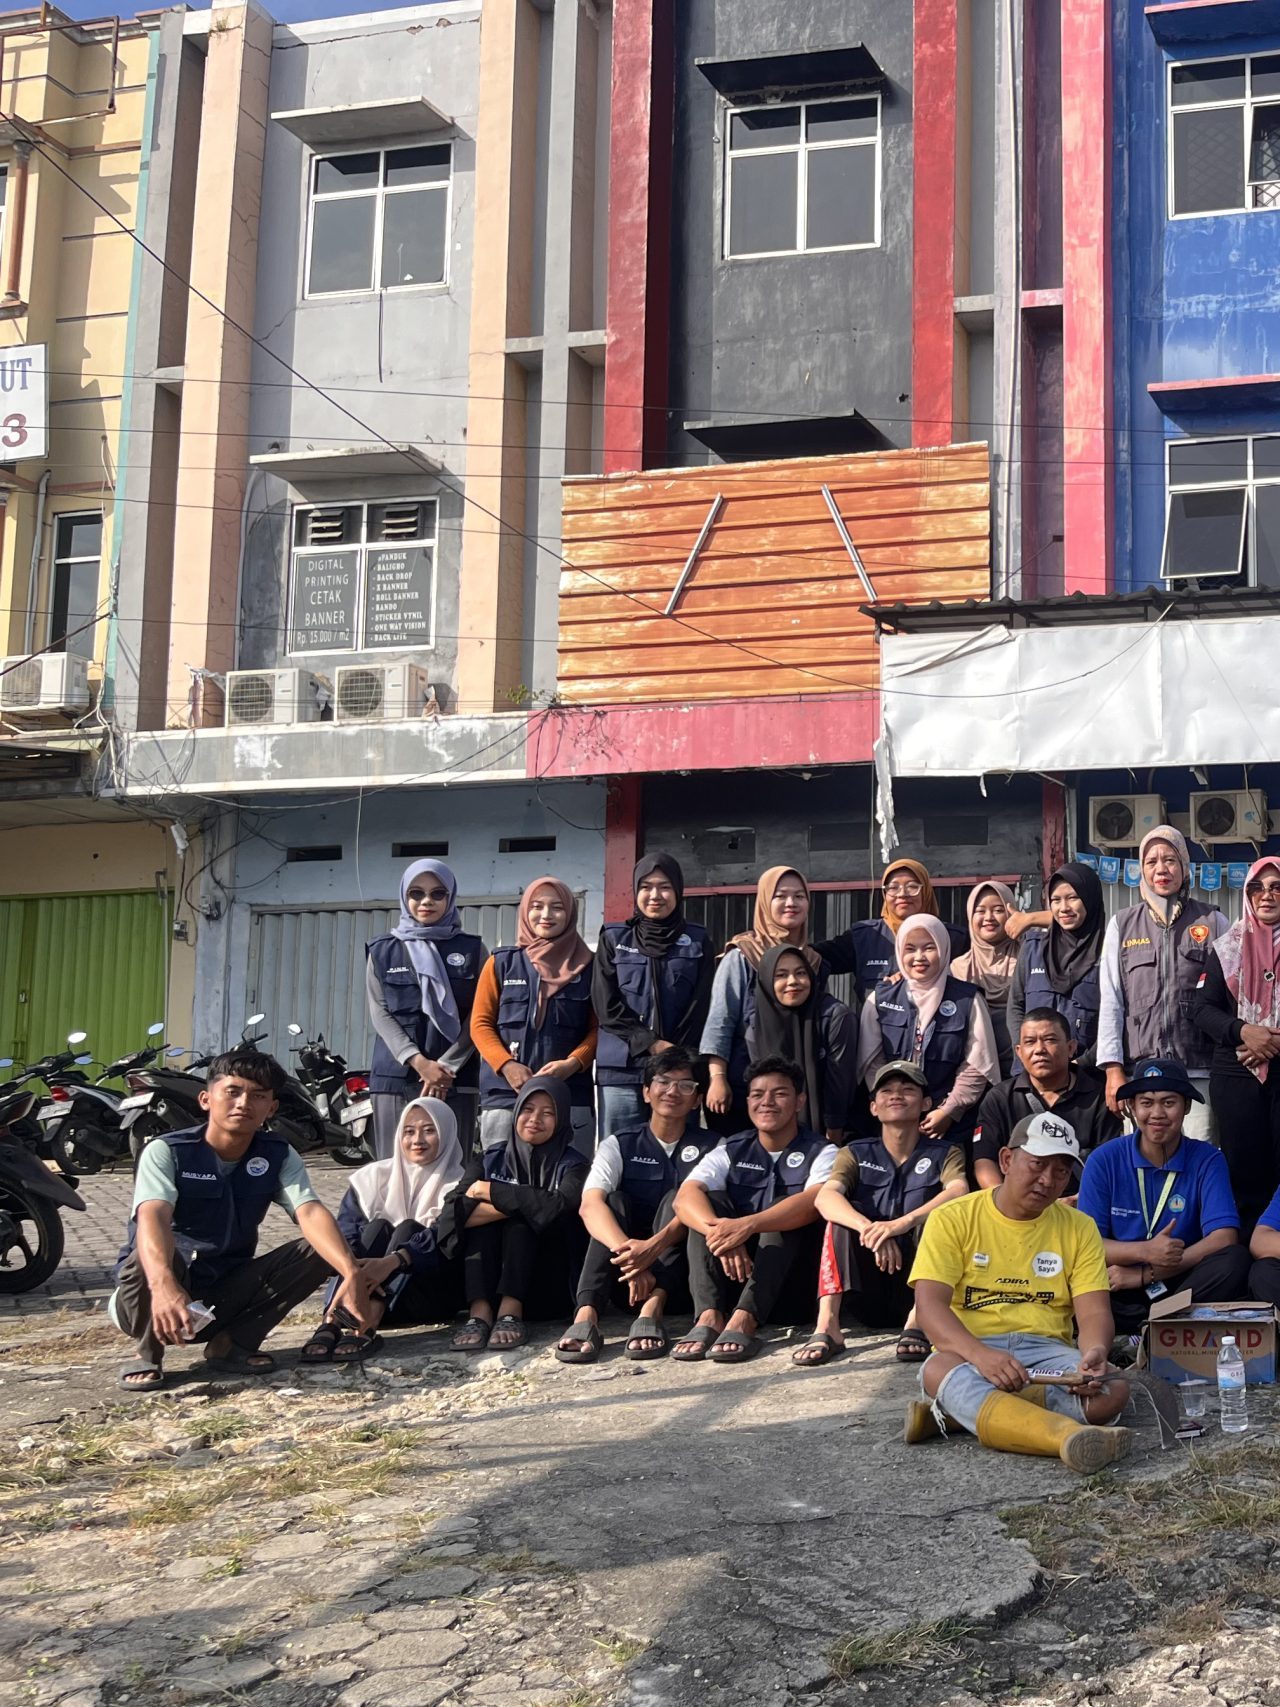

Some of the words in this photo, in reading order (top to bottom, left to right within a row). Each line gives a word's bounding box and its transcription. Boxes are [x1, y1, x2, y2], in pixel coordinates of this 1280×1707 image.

[0, 357, 32, 392] UT
[1, 413, 28, 448] 3
[308, 559, 344, 572] DIGITAL
[305, 573, 349, 588] PRINTING
[377, 573, 394, 582] BACK
[396, 571, 413, 581] DROP
[383, 582, 408, 591] BANNER
[310, 589, 342, 605] CETAK
[393, 592, 419, 601] BANNER
[305, 609, 345, 626] BANNER
[375, 613, 402, 621] STICKER
[374, 623, 388, 632] ONE
[389, 622, 402, 631] WAY
[404, 621, 427, 630] VISION
[374, 633, 391, 642] BACK
[1122, 937, 1151, 948] LINMAS
[1037, 1258, 1058, 1266] Tanya
[1038, 1266, 1056, 1274] Saya
[994, 1277, 1030, 1285] ADIRA
